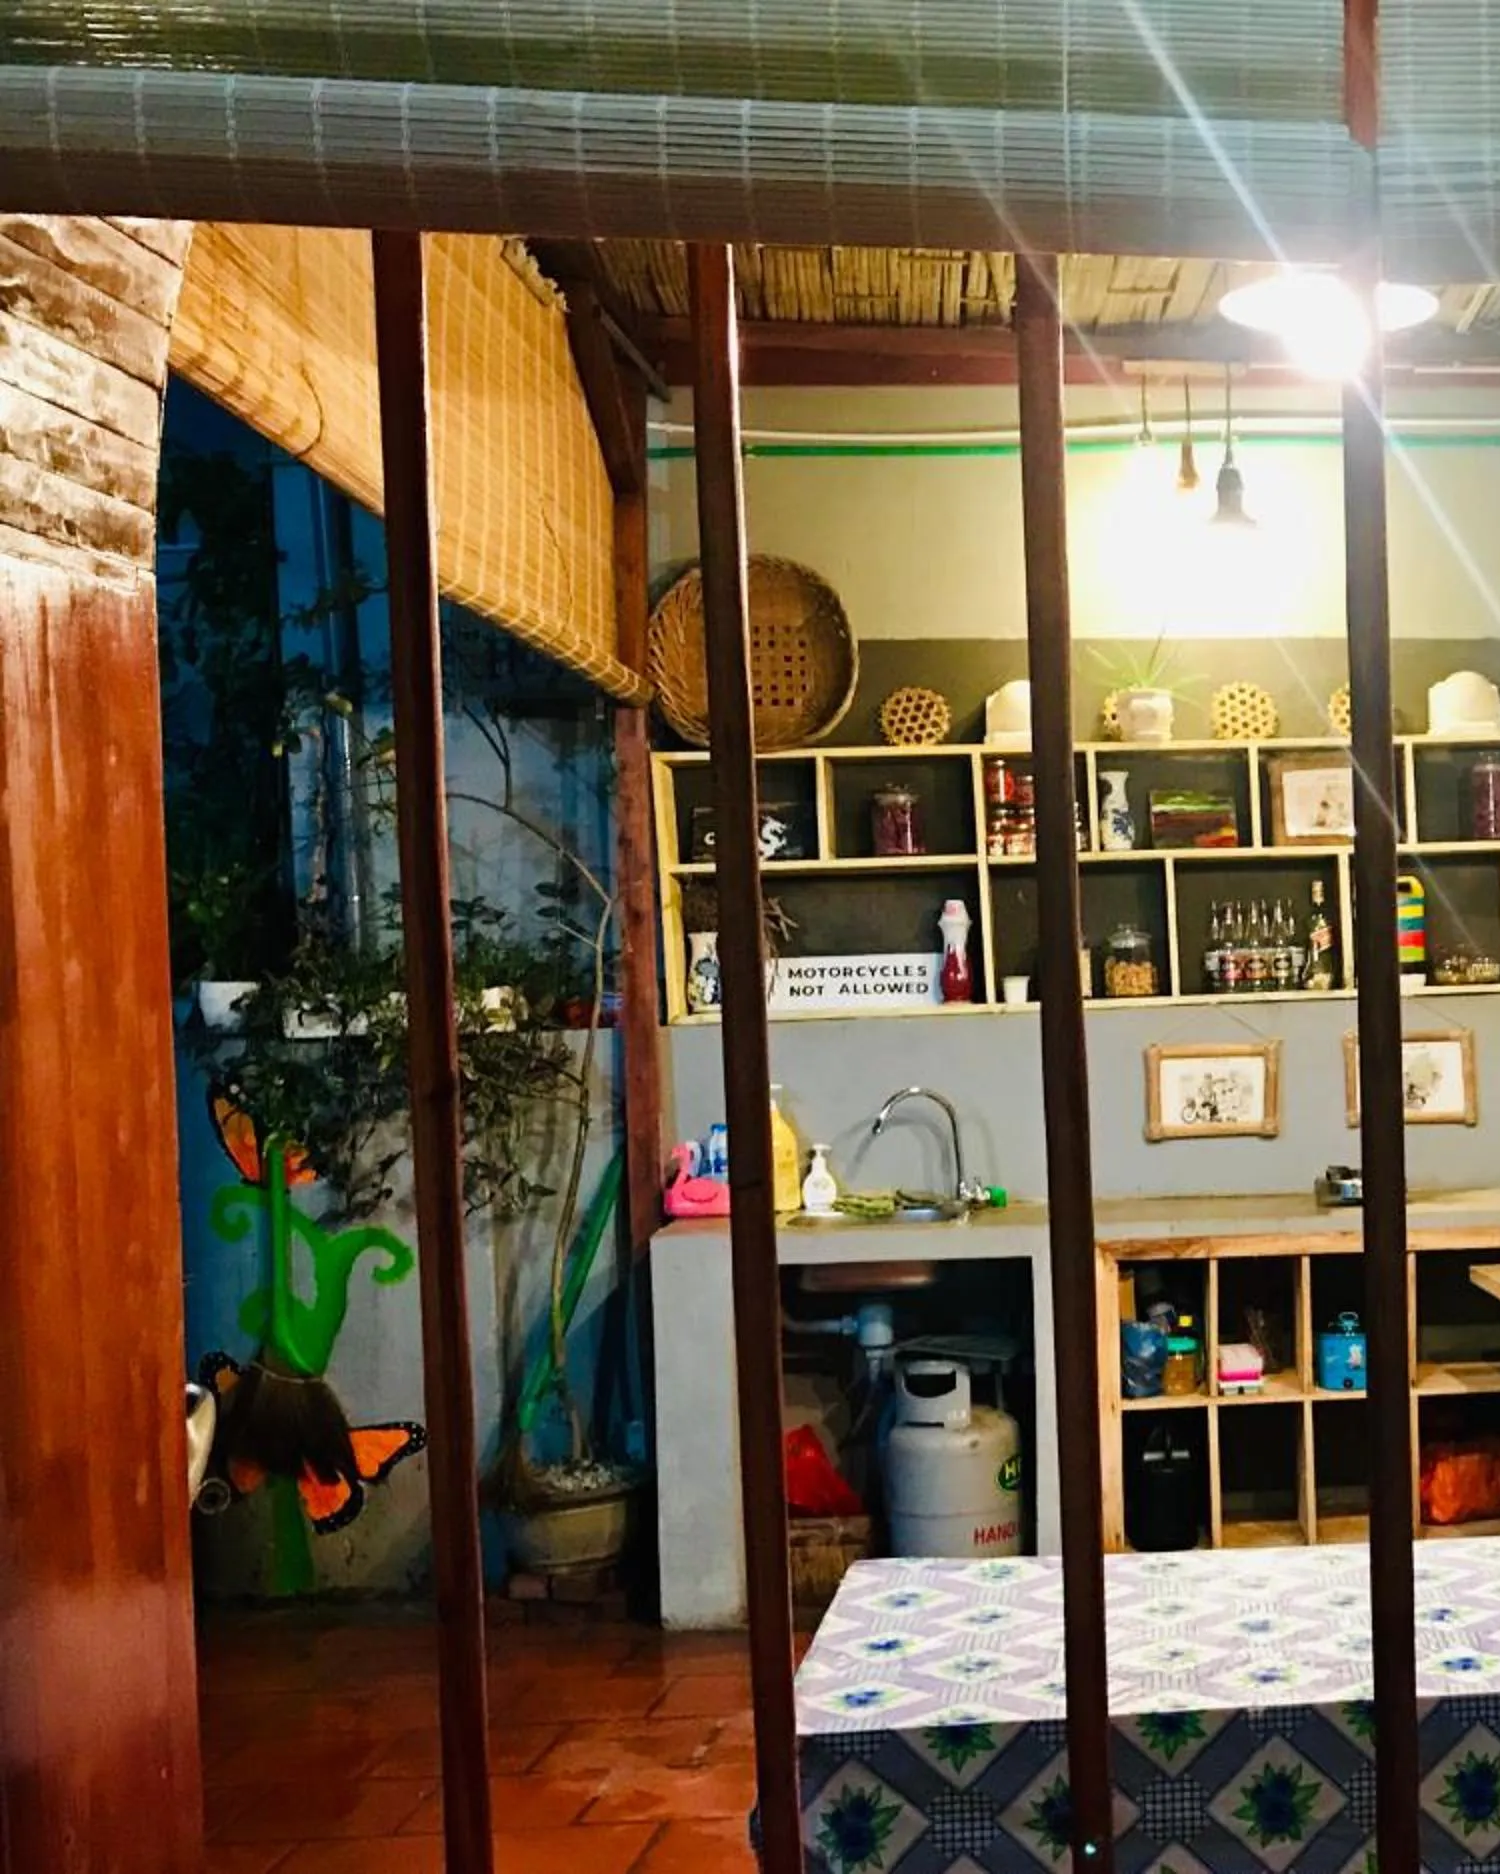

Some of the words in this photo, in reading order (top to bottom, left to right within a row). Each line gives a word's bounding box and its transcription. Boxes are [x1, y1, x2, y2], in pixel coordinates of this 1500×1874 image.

[788, 966, 927, 979] MOTORCYCLES
[789, 985, 824, 998] NOT
[839, 982, 929, 995] ALLOWED
